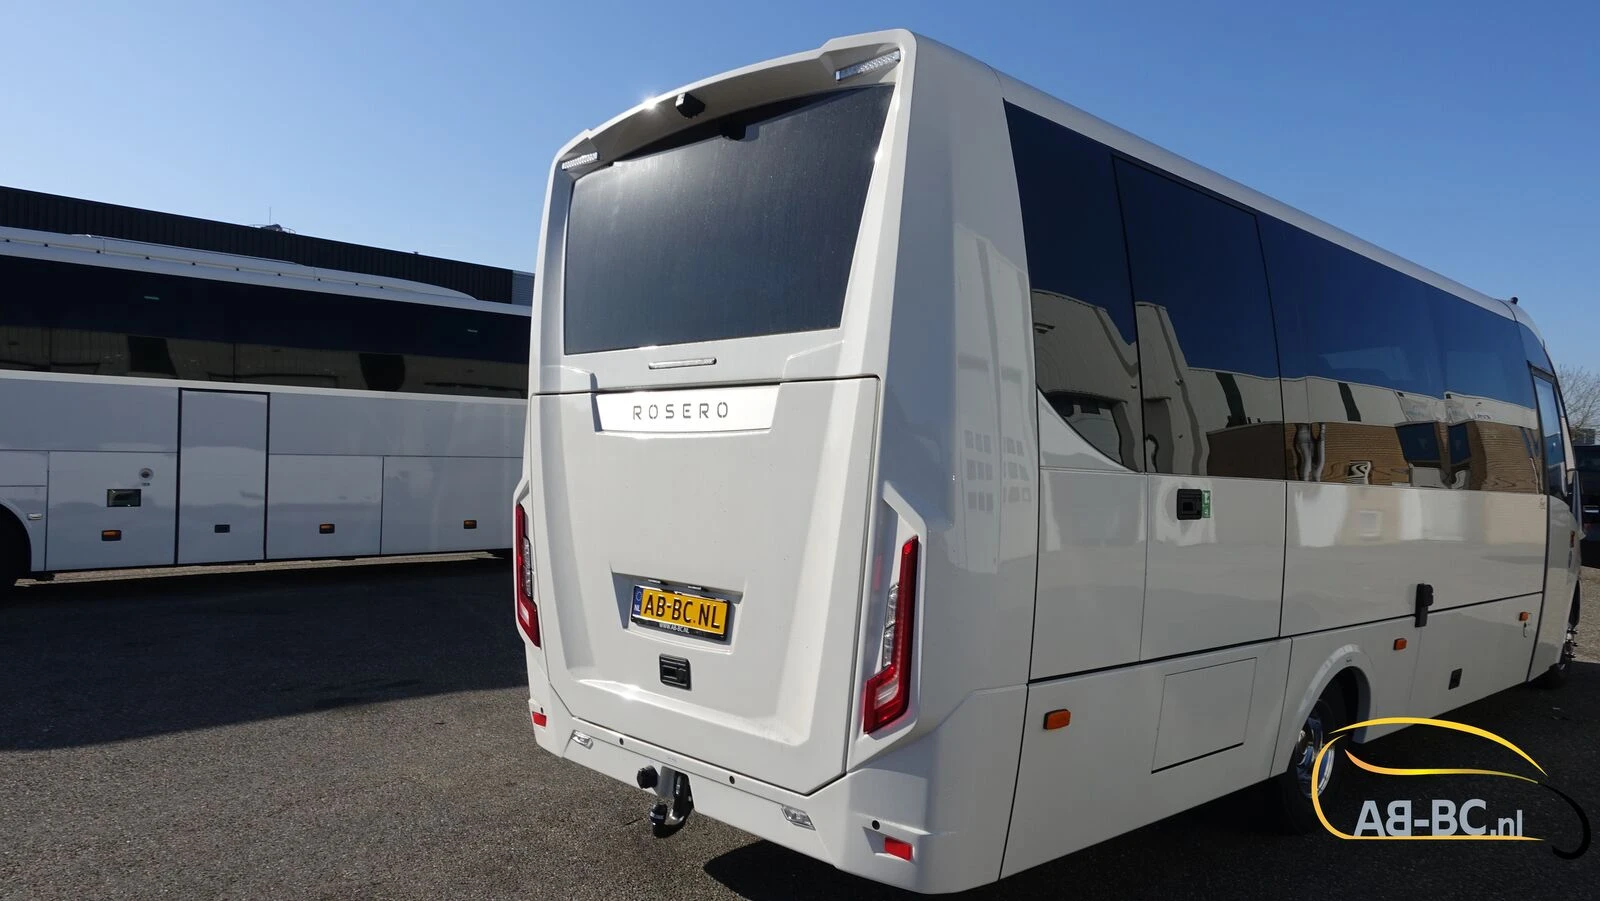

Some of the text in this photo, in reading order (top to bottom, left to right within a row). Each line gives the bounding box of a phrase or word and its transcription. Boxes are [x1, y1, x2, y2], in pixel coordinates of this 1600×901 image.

[632, 402, 729, 420] ROSERO
[633, 604, 641, 612] NL
[643, 593, 721, 630] AB-BC.NL
